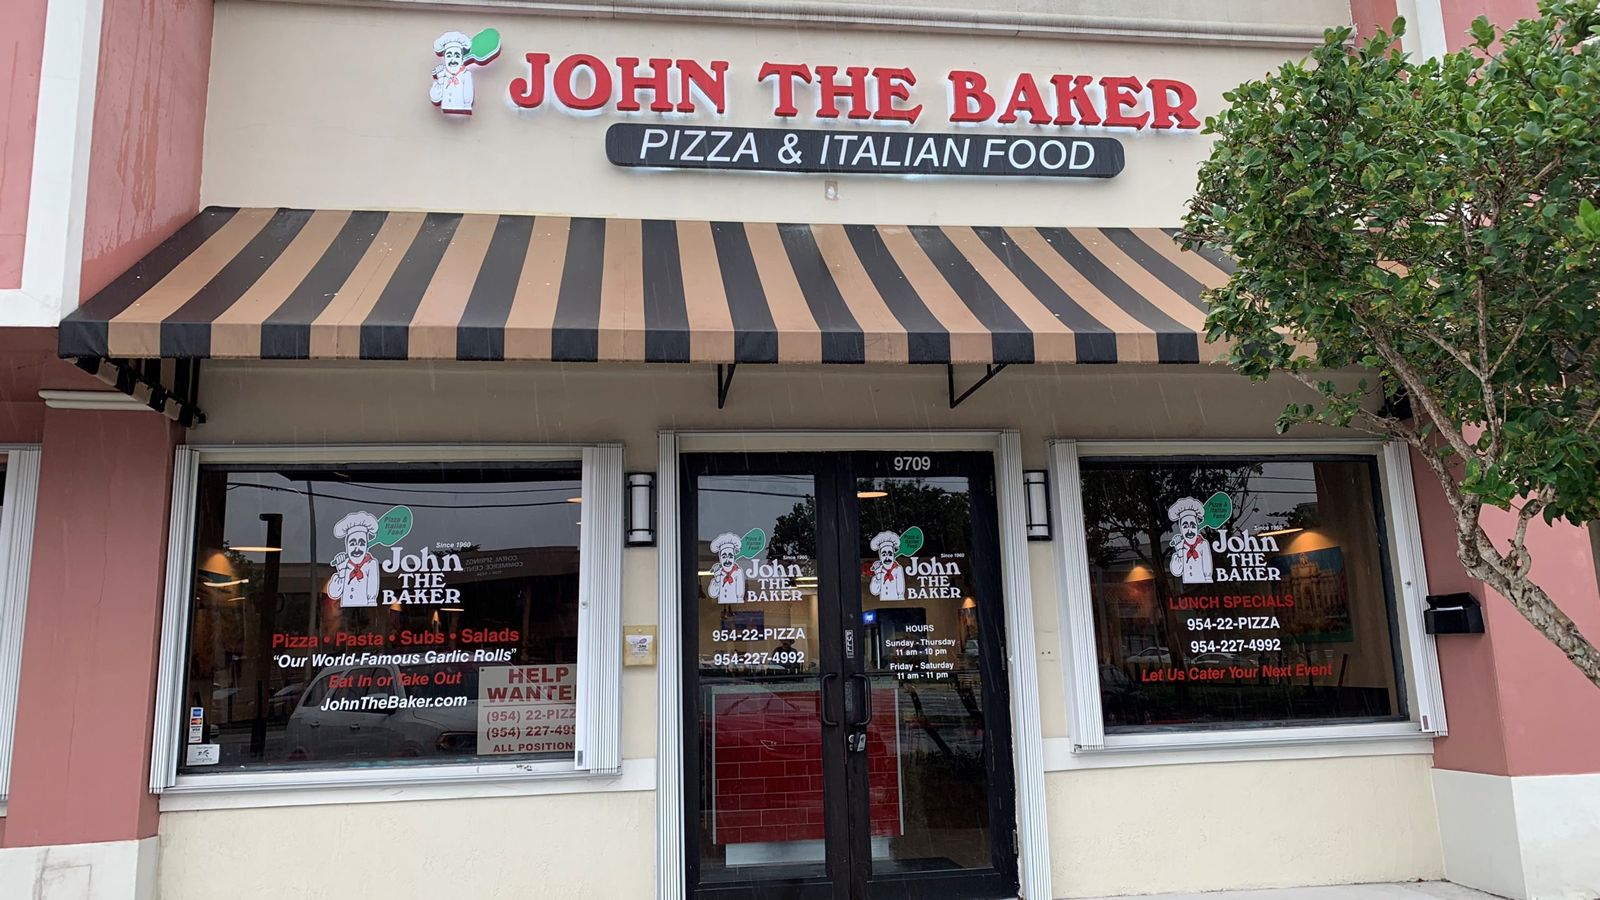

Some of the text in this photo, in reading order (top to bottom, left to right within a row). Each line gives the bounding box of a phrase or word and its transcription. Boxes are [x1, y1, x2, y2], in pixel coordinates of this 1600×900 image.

[509, 53, 1201, 131] JOHN THE BAKER
[640, 129, 1096, 171] PIZZA & ITALIAN FOOD
[894, 456, 931, 471] 9709
[1212, 529, 1279, 553] John
[382, 546, 463, 573] John
[905, 556, 961, 576] John
[1227, 553, 1267, 567] THE
[745, 559, 803, 578] John
[1216, 567, 1281, 582] BAKER
[398, 573, 447, 589] THE
[758, 578, 793, 590] THE
[917, 576, 950, 587] THE
[382, 588, 461, 605] BAKER
[747, 590, 803, 602] BAKER
[907, 587, 961, 599] BAKER
[1170, 595, 1295, 610] LUNCH SPECIALS
[1186, 616, 1280, 631] 954-22-PIZZA
[272, 633, 318, 648] Pizza
[336, 632, 384, 647] Pasta
[400, 630, 445, 645] Subs
[462, 628, 520, 643] Salads
[712, 627, 806, 642] 954-22-PIZZA
[885, 639, 914, 648] Sunday
[920, 638, 956, 647] Thursday
[1190, 639, 1281, 654] 954-227-4992
[312, 651, 420, 667] World-Famous
[425, 650, 470, 664] Garlic
[714, 651, 805, 666] 954-227-4992
[890, 662, 913, 671] Friday
[920, 662, 954, 670] Saturday
[328, 671, 462, 689] Eat In or Take Out
[508, 667, 569, 684] HELP
[1142, 664, 1332, 682] Let Us Cater Your Next Event
[487, 685, 577, 703] WANTE
[321, 695, 467, 711] JohnTheBaker.com
[486, 709, 576, 725] (954) 22-PIZZ
[486, 724, 576, 741] (954) 227-499
[493, 741, 575, 753] ALL POSITION
